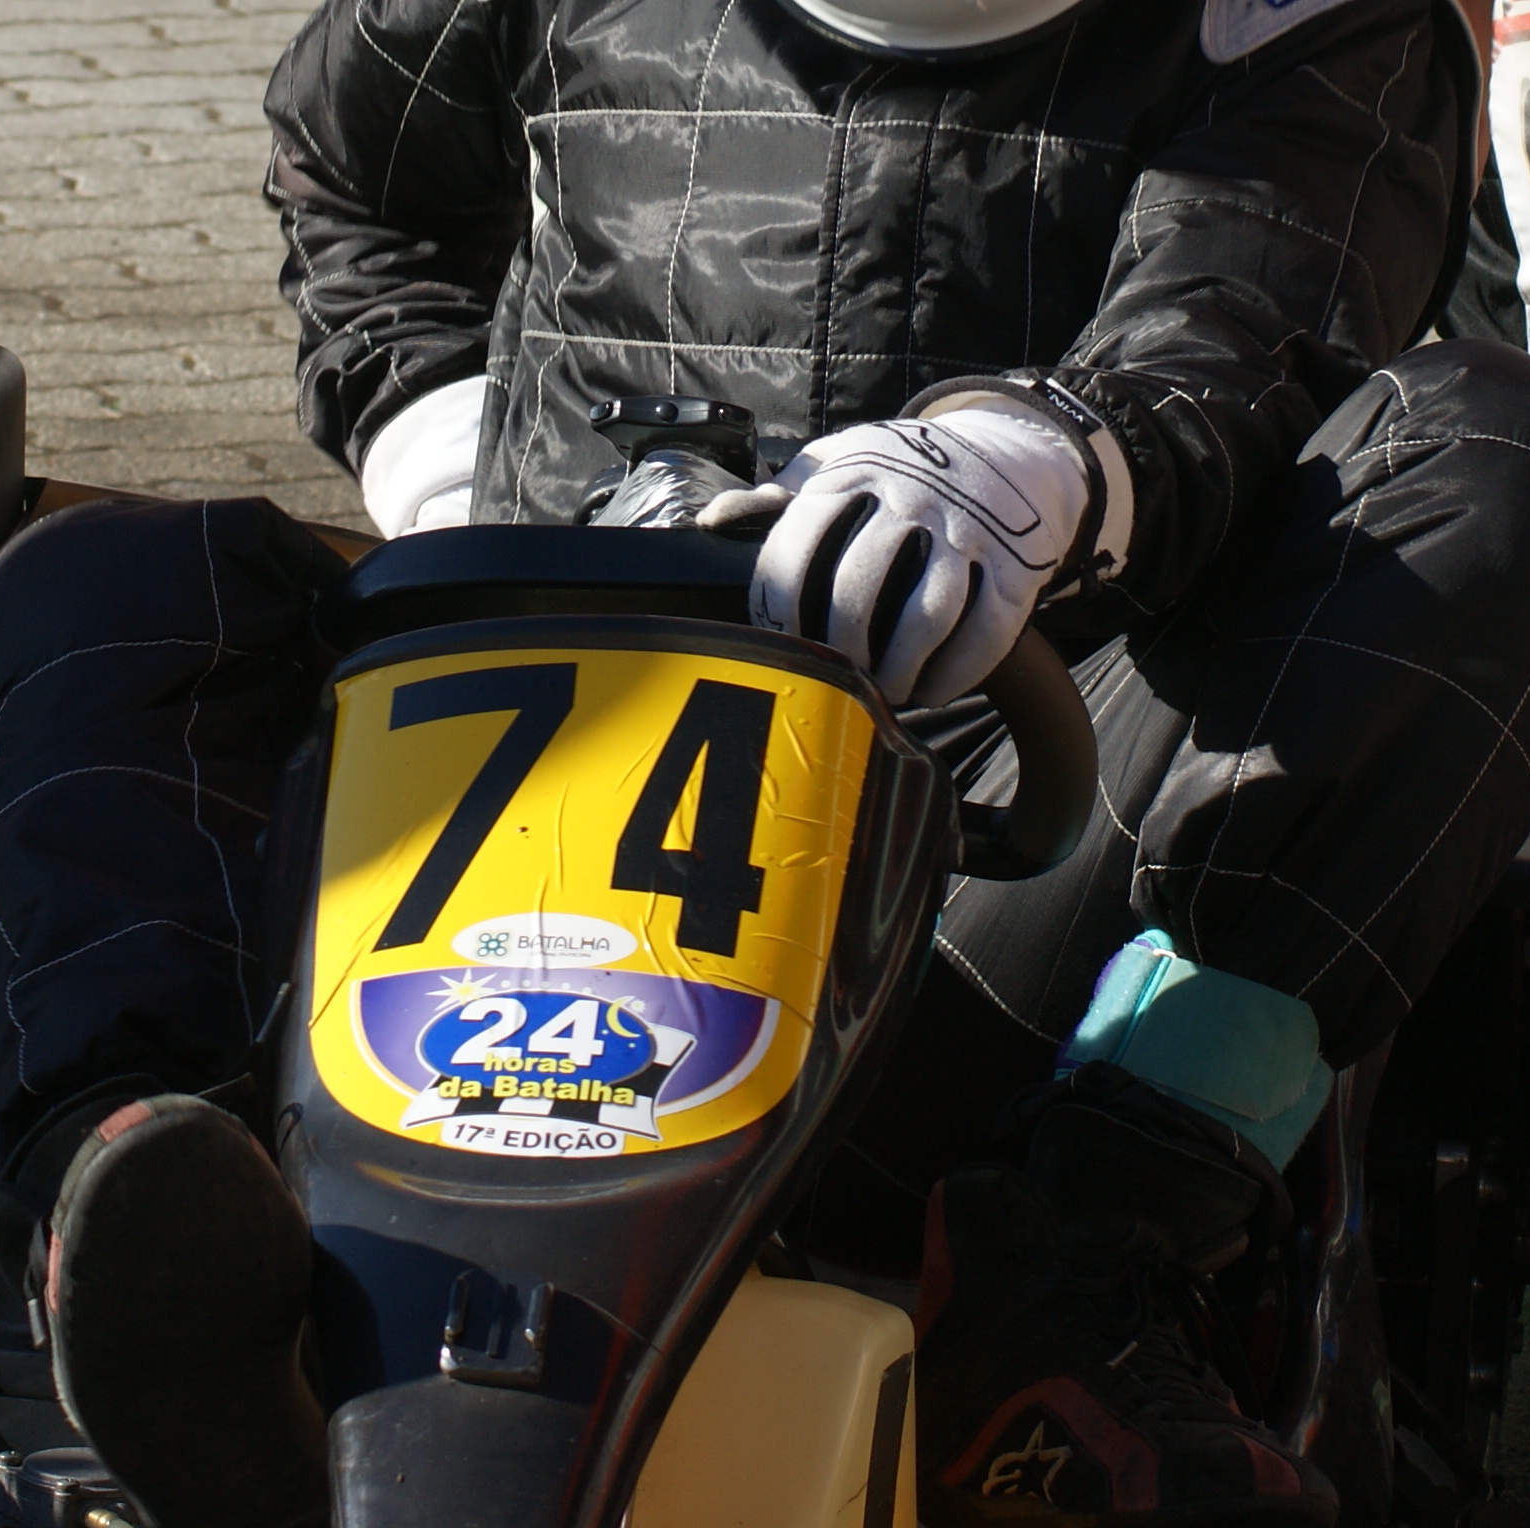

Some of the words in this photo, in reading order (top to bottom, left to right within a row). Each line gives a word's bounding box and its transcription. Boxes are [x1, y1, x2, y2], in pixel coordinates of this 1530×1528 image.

[371, 661, 777, 959] 74
[517, 934, 611, 952] BATALHA
[451, 997, 605, 1066] 24
[483, 1053, 578, 1074] horas
[437, 1075, 483, 1099] da
[492, 1075, 636, 1106] Batalha
[502, 1127, 618, 1155] EDIÇÃO
